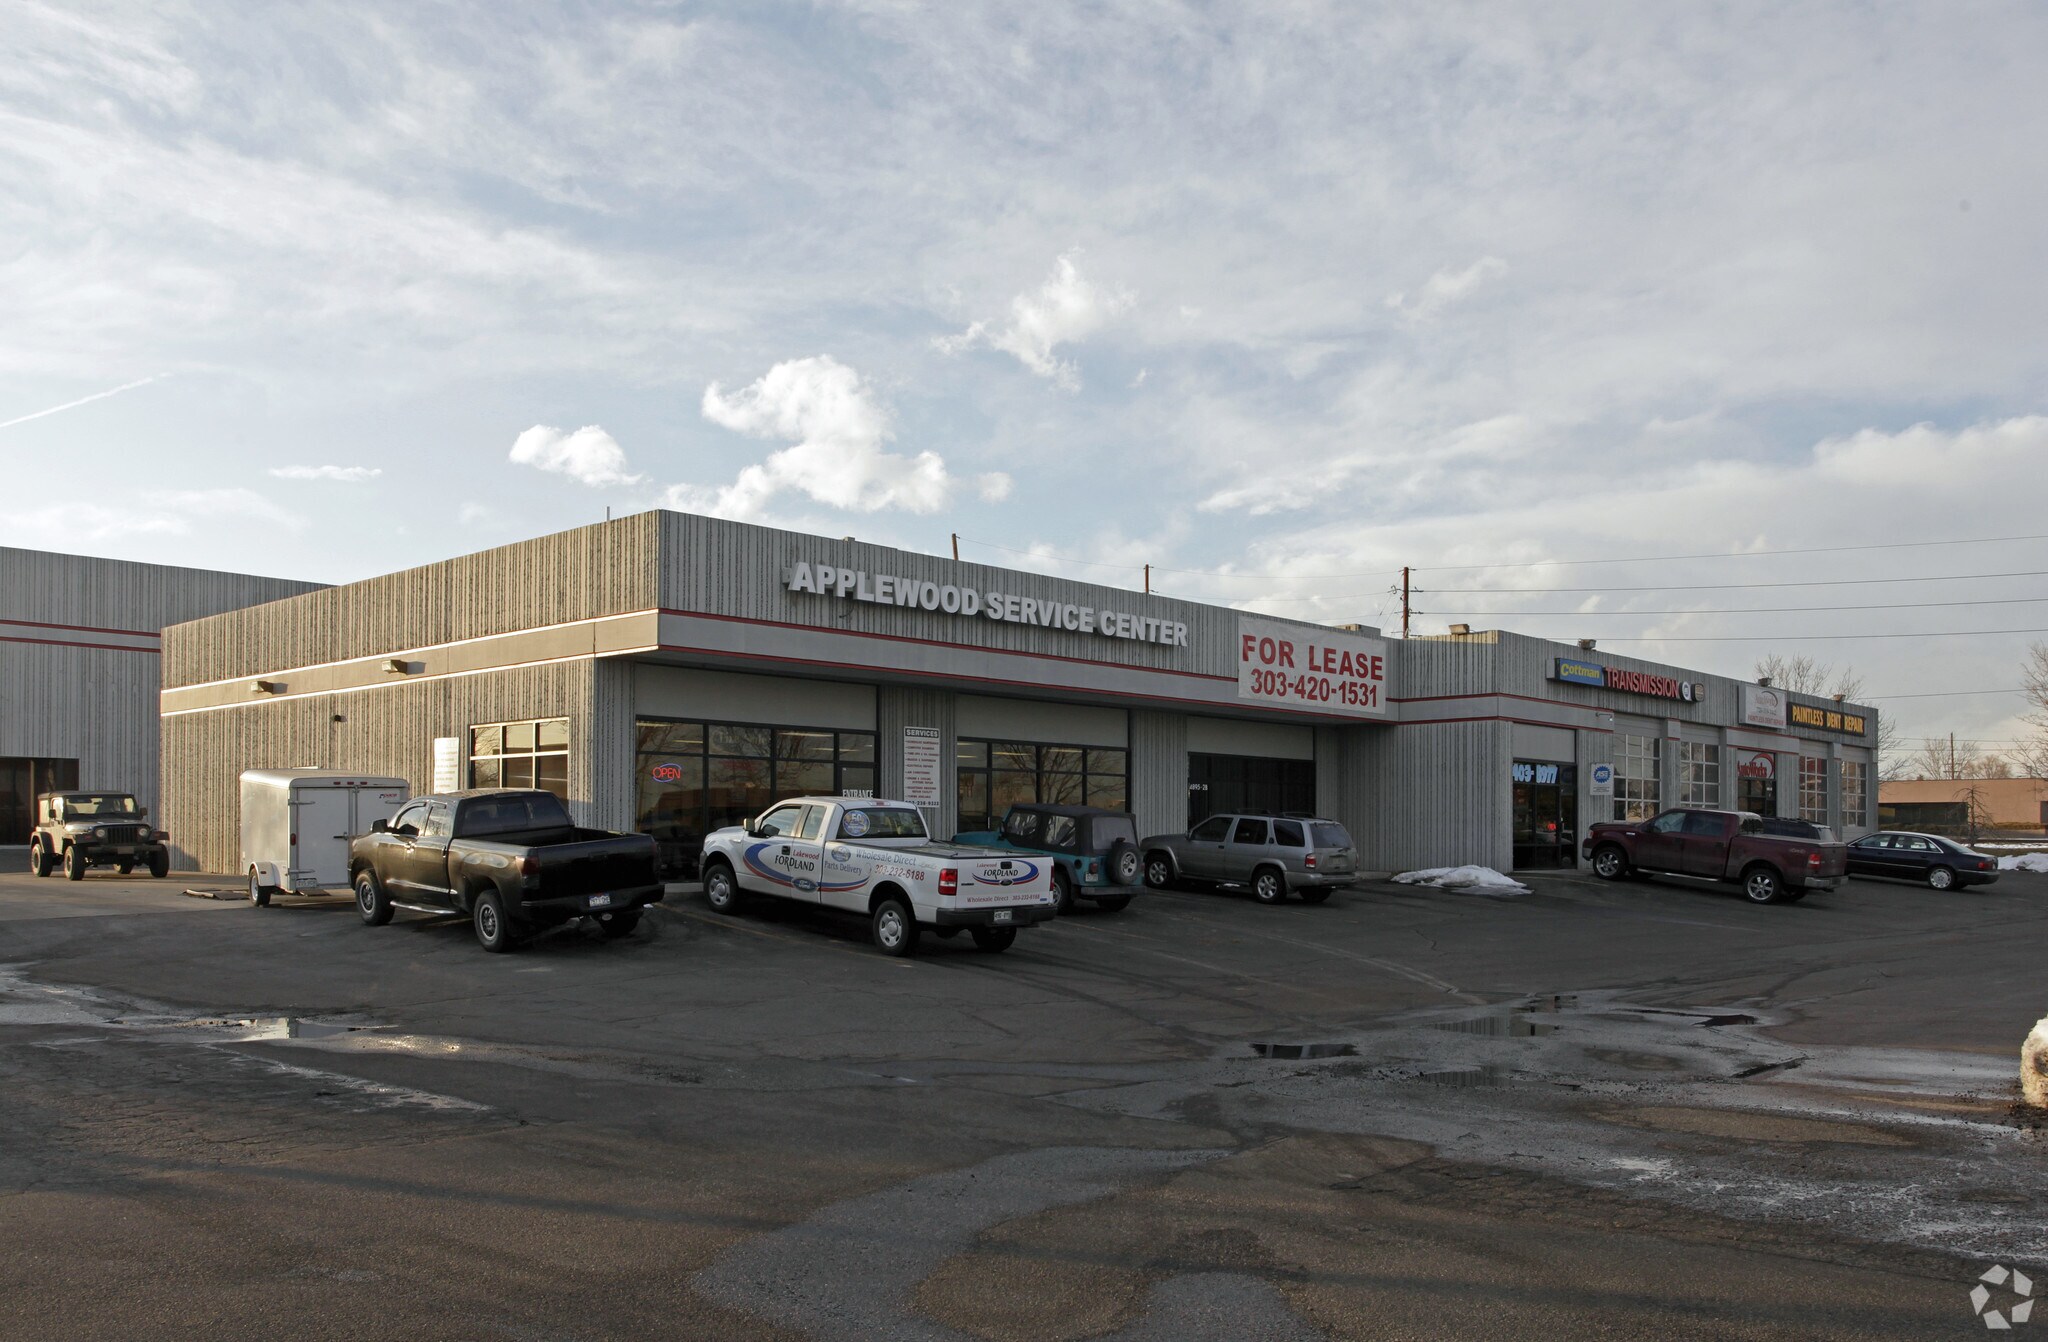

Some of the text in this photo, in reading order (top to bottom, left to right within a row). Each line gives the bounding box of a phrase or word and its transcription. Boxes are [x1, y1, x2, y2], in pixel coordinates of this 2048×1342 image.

[788, 562, 1188, 647] APPLEWOOD SERVICE CENTER
[1242, 634, 1383, 681] FOR LEASE
[1250, 668, 1377, 708] 303-420-1531
[1560, 663, 1601, 679] Cottman
[1605, 667, 1680, 698] TRANSMISSION
[1792, 704, 1824, 726] PAINTLESS
[1827, 710, 1842, 730] DENT
[1844, 714, 1863, 732] REPAIR
[906, 729, 938, 737] SERVICES
[652, 767, 681, 779] OPEN
[842, 789, 874, 798] ENTRANCE
[793, 849, 820, 860] Lakewood
[856, 849, 892, 862] Wholesale
[894, 854, 917, 866] Direct
[775, 855, 815, 872] FORDLAND
[824, 861, 862, 875] Parts Delivery
[874, 864, 925, 881] 303-232-6188
[983, 869, 1019, 879] FORDLAND
